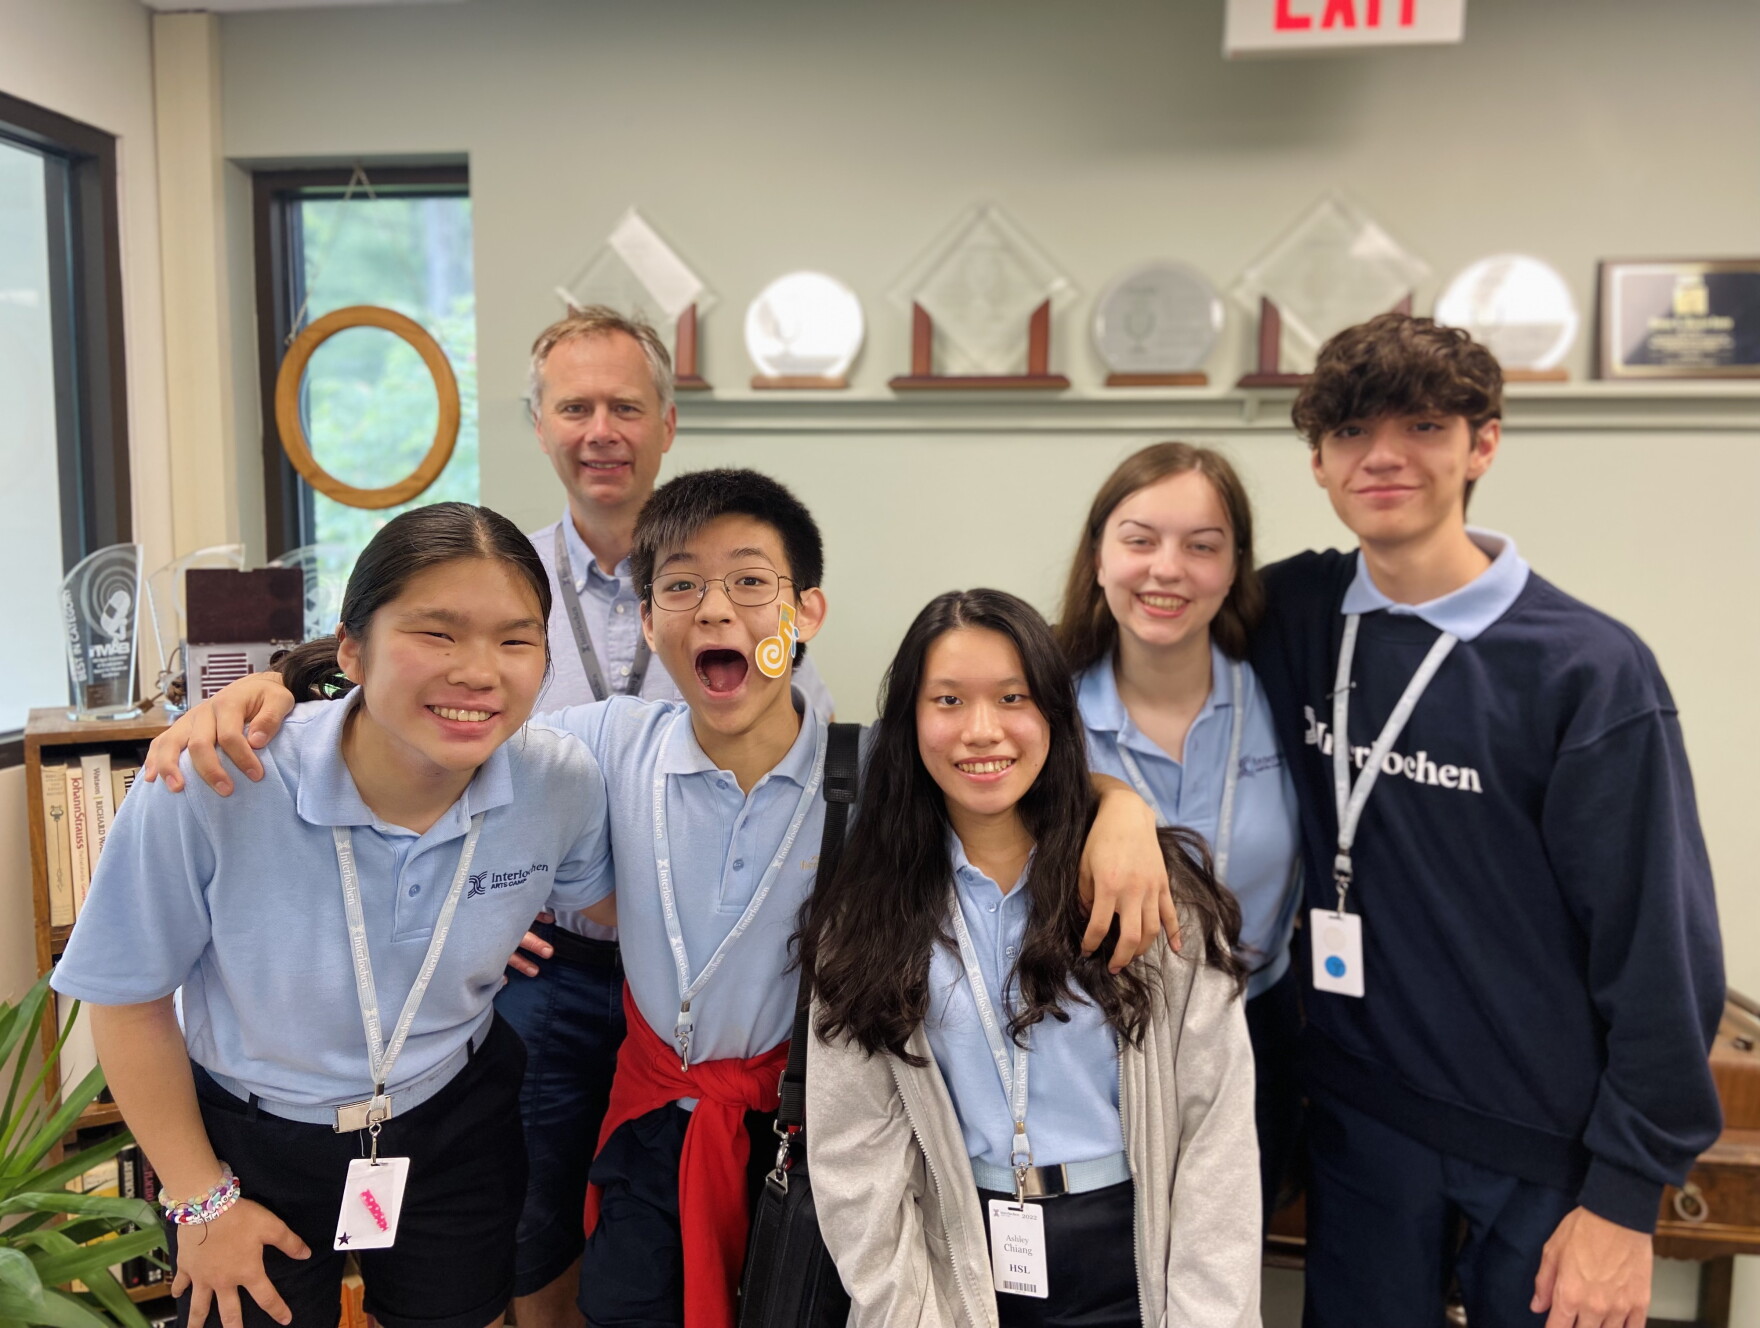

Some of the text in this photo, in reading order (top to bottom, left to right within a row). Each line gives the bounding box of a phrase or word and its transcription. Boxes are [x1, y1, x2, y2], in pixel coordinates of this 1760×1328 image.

[1317, 721, 1483, 794] Irochen
[96, 800, 106, 836] RICHARD
[654, 789, 664, 839] Interlochen
[777, 813, 805, 860] Interlochen
[340, 851, 356, 905] Interlochen
[454, 841, 476, 894] Interlochen
[491, 864, 549, 883] Interlochen
[491, 882, 508, 890] ARTS
[660, 869, 673, 919] Interlochen
[738, 887, 769, 931] Interlochen
[354, 935, 369, 989] Interlochen
[972, 976, 993, 1029] Interlochen
[1000, 1059, 1013, 1100] Interlo
[1016, 1054, 1027, 1106] Interlochen
[1022, 1213, 1037, 1221] 2022
[1003, 1243, 1033, 1256] Chiang
[1006, 1234, 1029, 1246] Ashley
[1009, 1263, 1031, 1274] HSL
